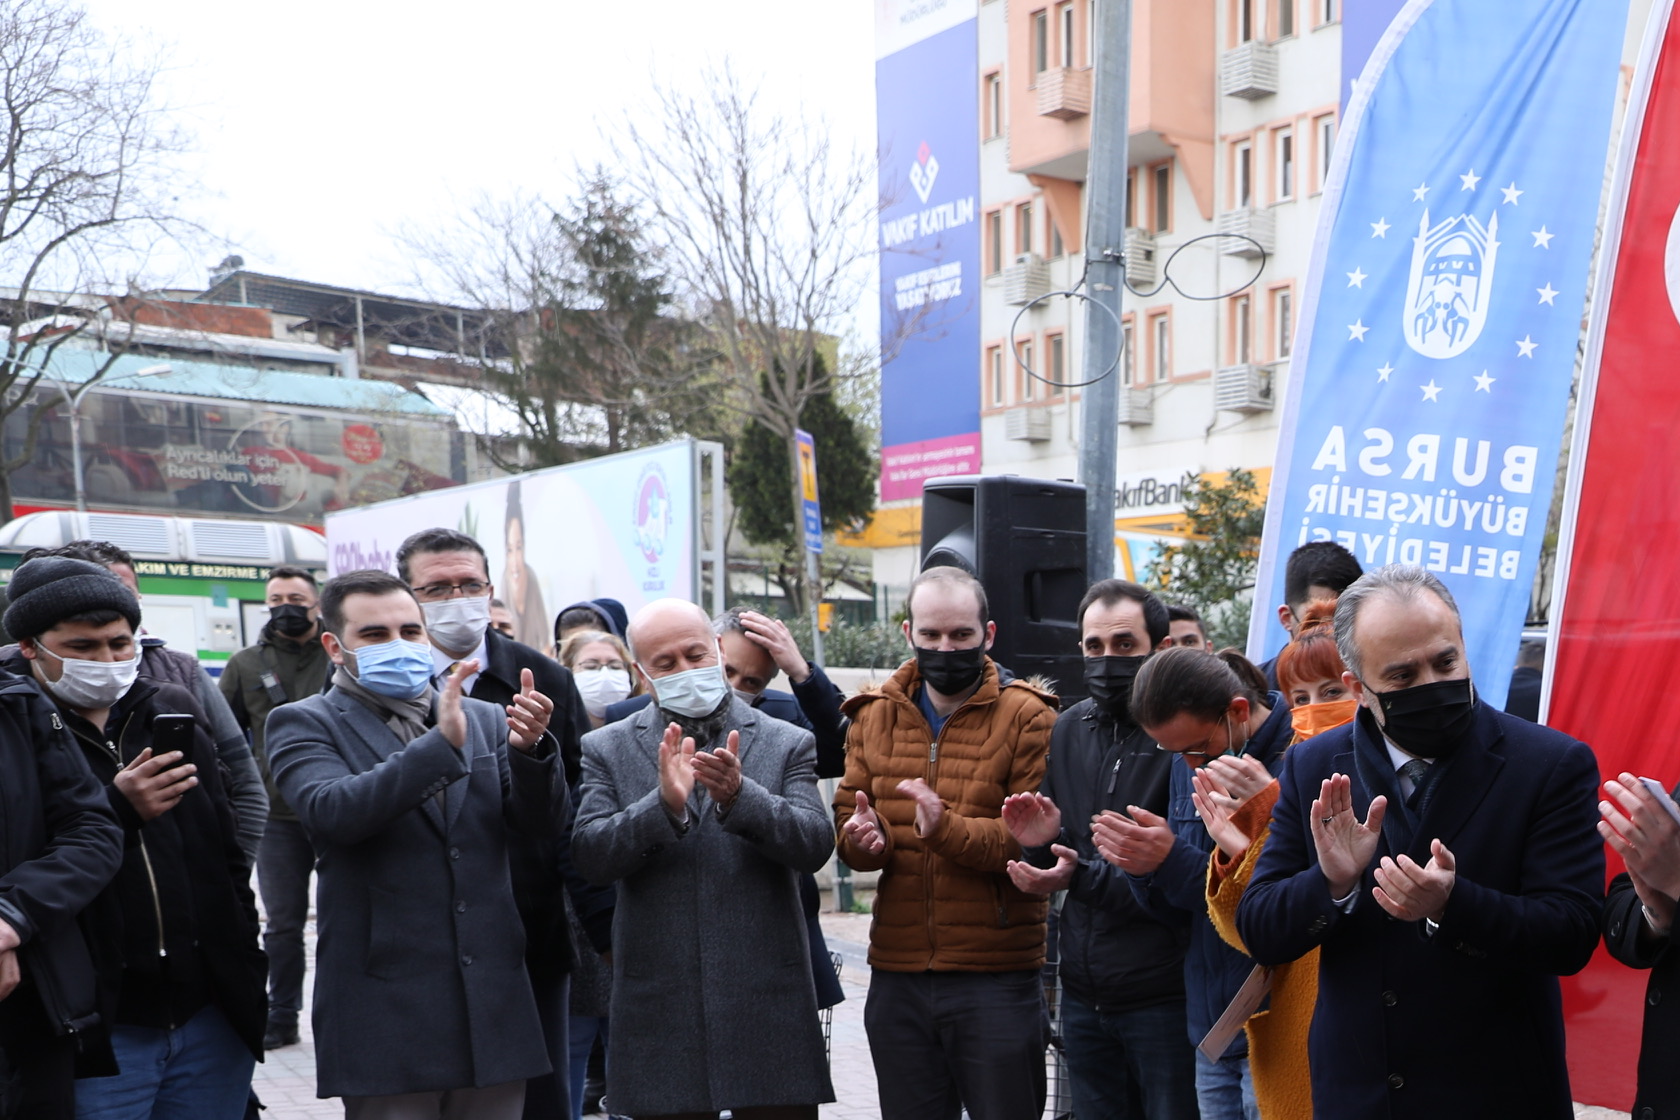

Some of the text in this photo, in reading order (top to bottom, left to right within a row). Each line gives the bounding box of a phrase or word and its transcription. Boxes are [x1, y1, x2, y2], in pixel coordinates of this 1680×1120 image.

[920, 196, 974, 236] KATILIM
[166, 443, 279, 470] Ayrıcalıklar için
[213, 469, 248, 483] olun
[1114, 475, 1186, 509] akıfBan
[168, 563, 189, 576] VE
